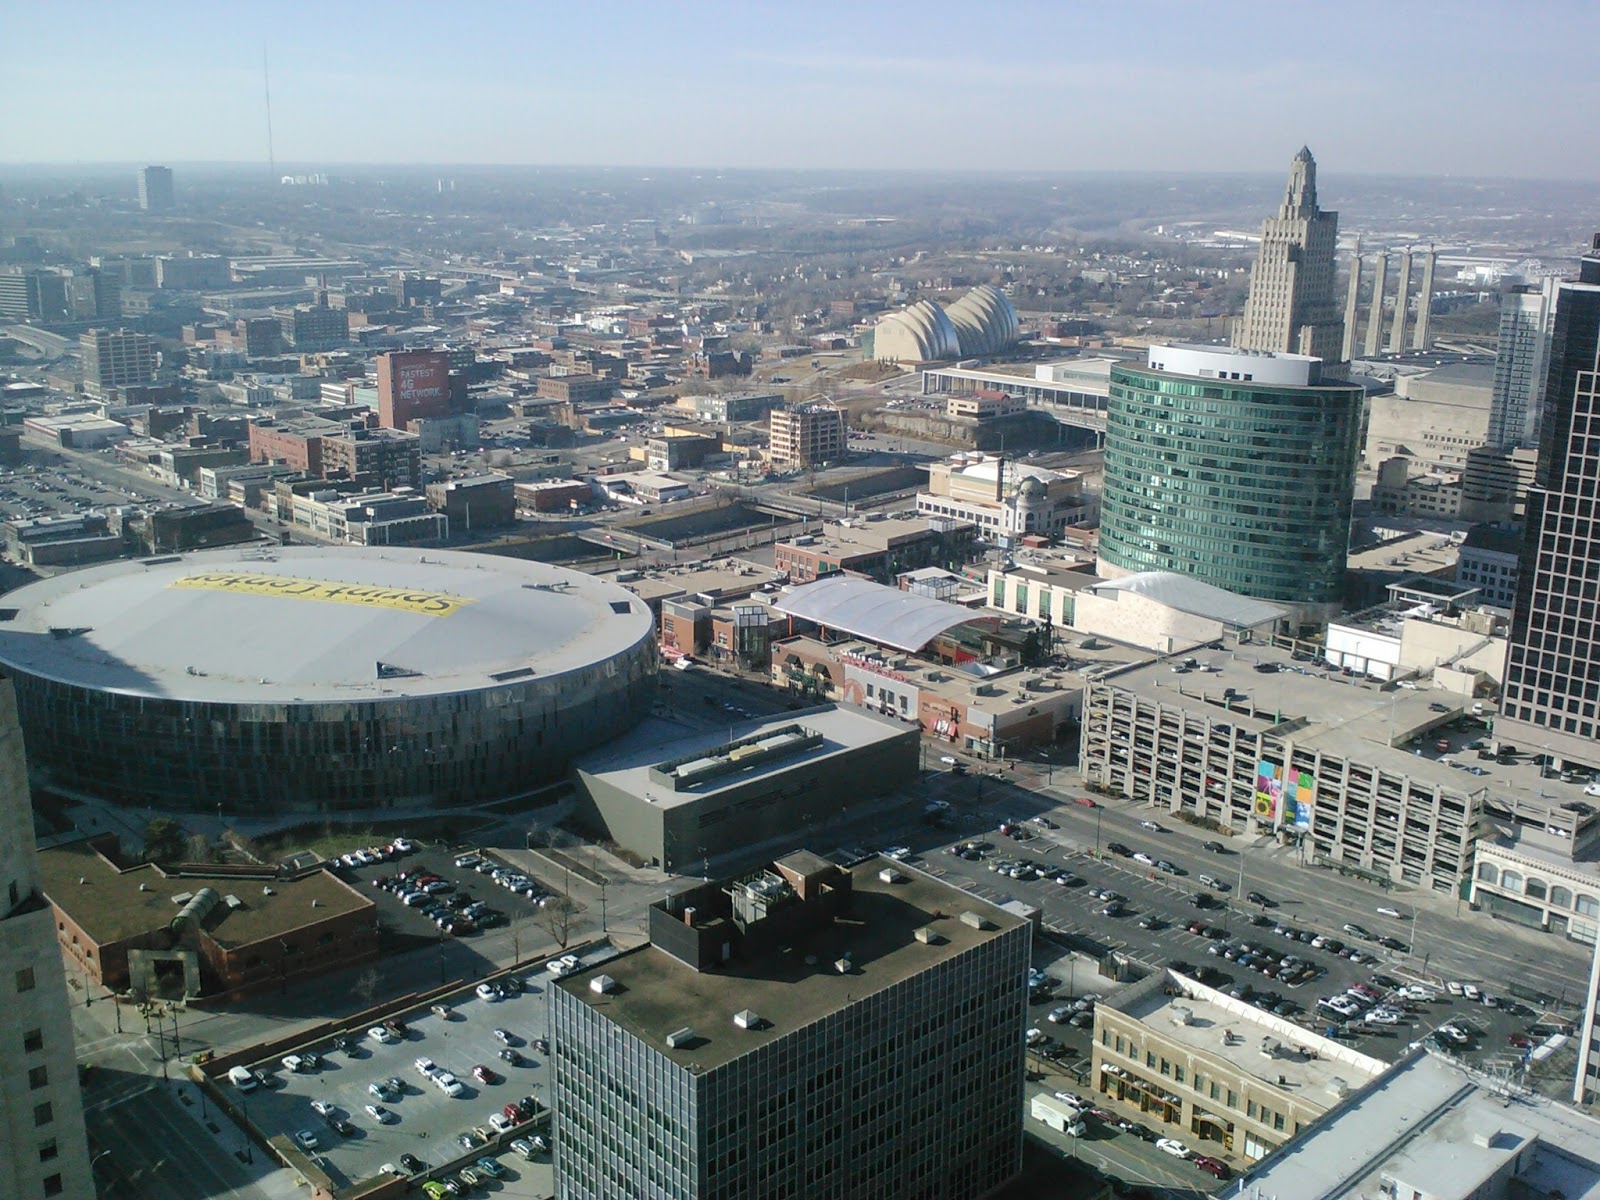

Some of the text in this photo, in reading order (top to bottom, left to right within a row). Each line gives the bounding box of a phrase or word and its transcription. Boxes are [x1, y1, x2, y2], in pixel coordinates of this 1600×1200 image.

[400, 369, 434, 378] FASTEST
[400, 379, 414, 390] 4G
[183, 574, 452, 611] Sprint Center
